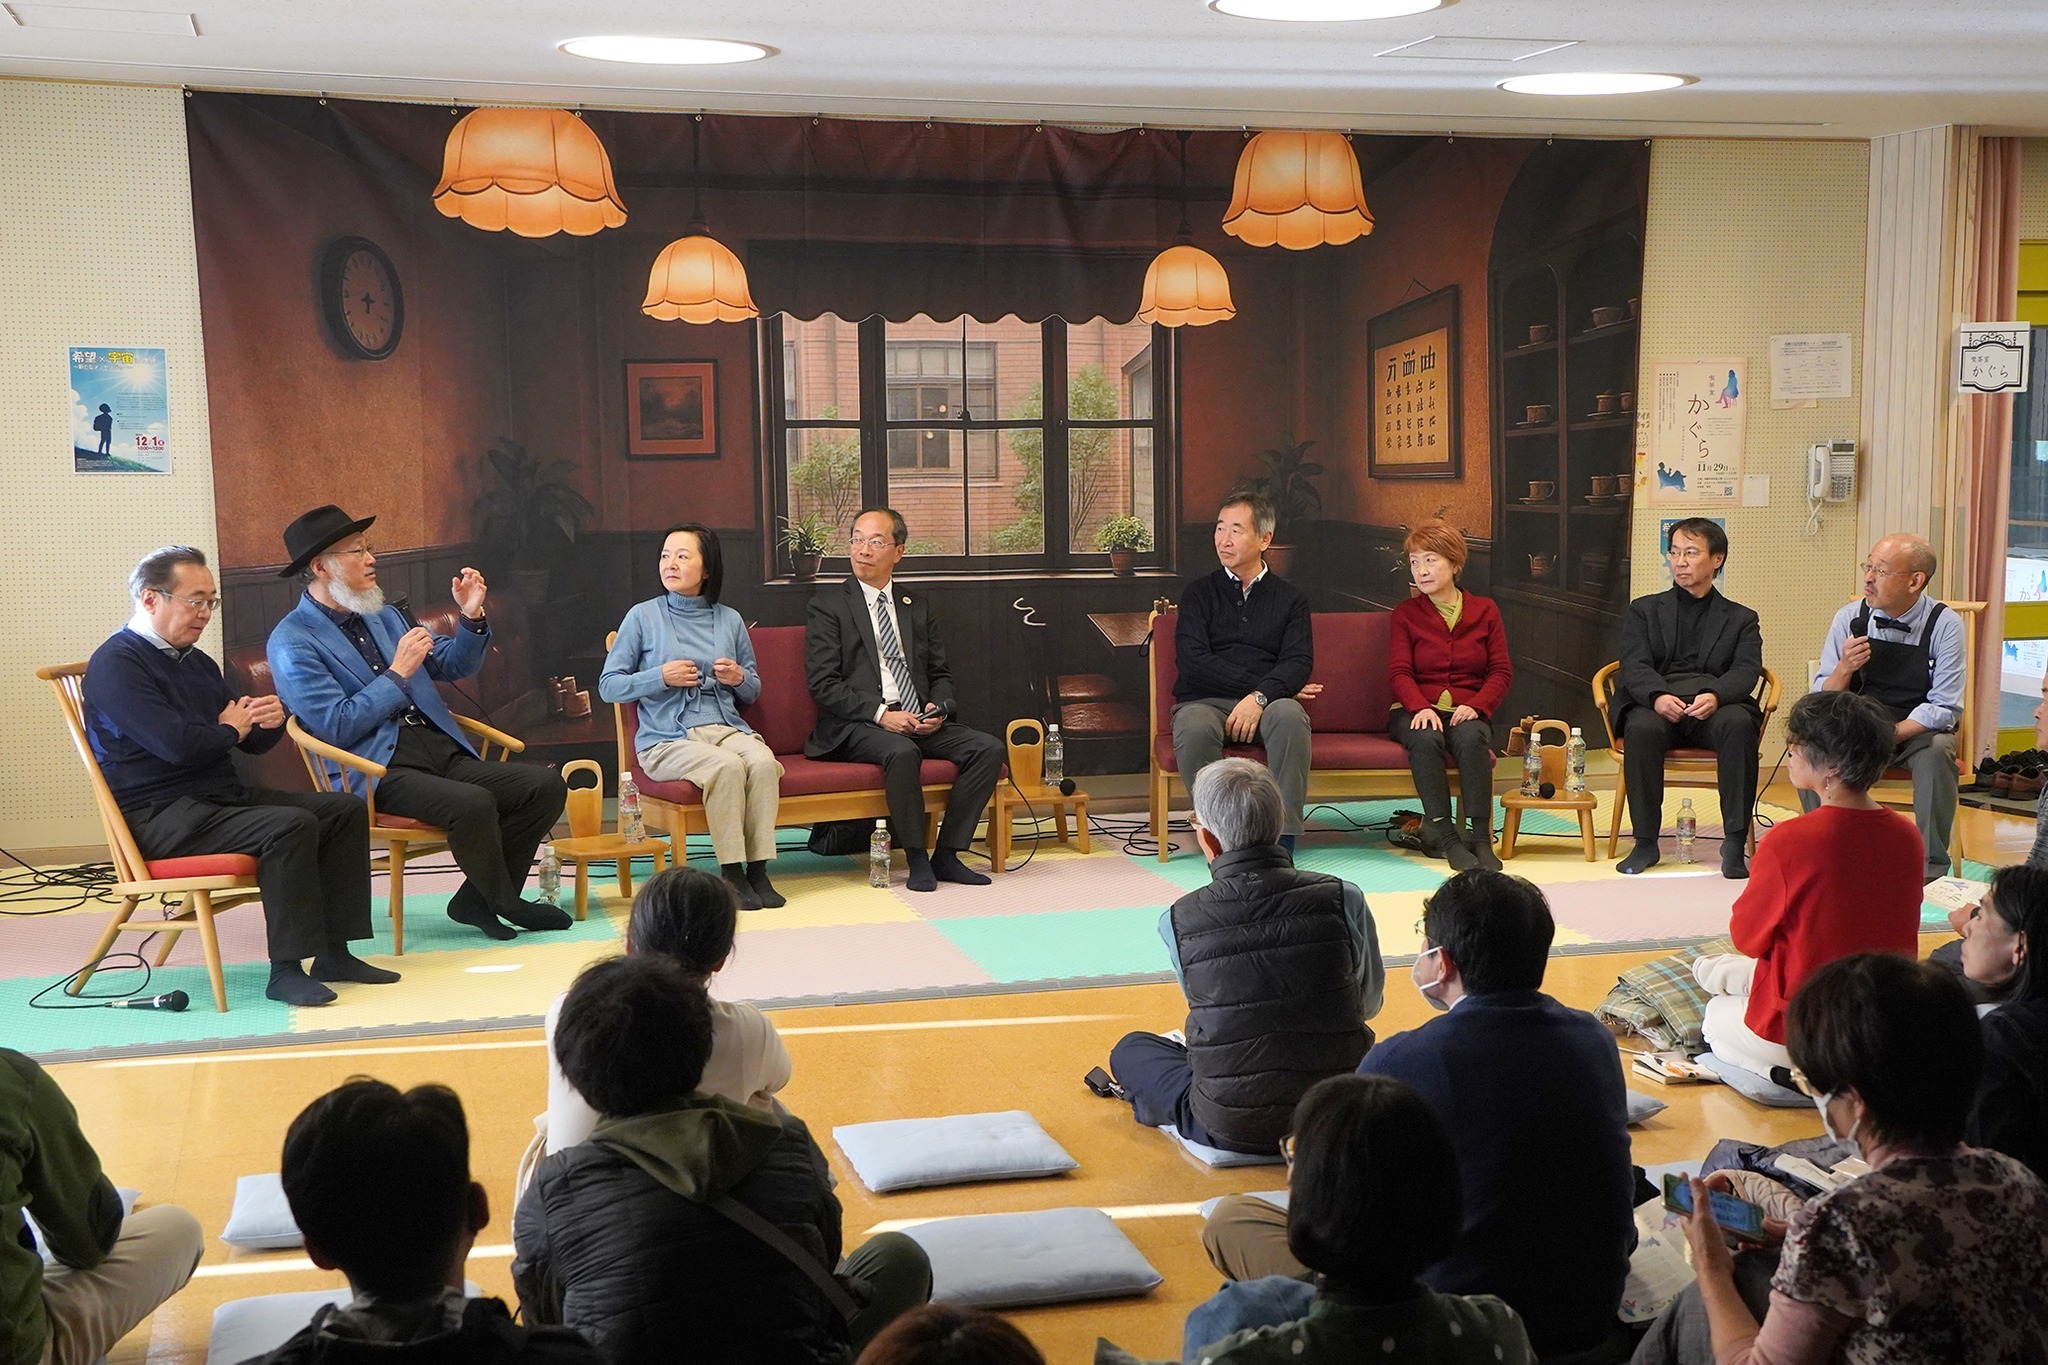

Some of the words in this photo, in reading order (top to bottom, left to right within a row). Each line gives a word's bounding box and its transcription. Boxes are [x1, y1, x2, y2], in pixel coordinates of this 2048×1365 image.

[1973, 365, 2009, 378] かぐら
[1687, 394, 1710, 459] かぐら
